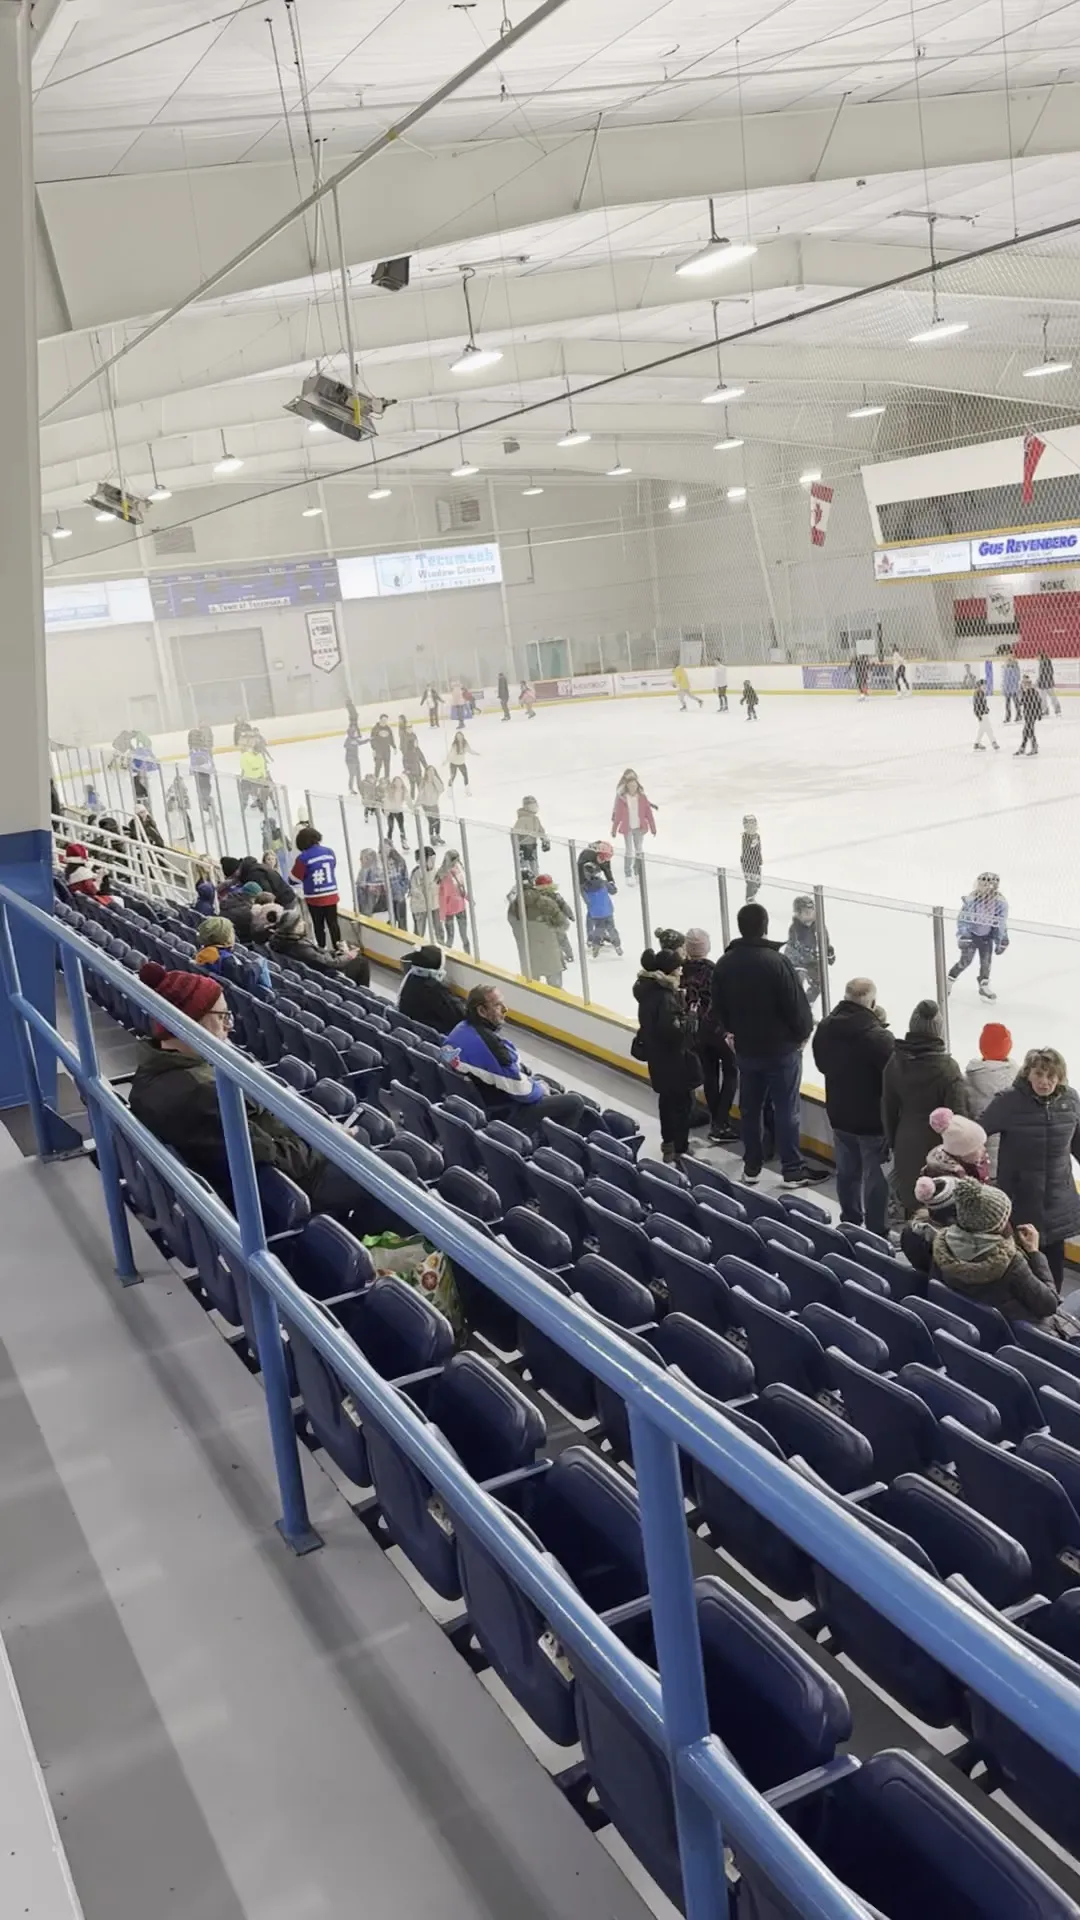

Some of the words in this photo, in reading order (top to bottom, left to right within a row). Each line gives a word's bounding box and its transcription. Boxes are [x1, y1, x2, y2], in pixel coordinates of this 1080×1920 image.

[979, 541, 1004, 556] GUS
[1006, 535, 1078, 554] REVENBERG
[415, 547, 494, 569] Tecumseh
[312, 862, 333, 885] #1
